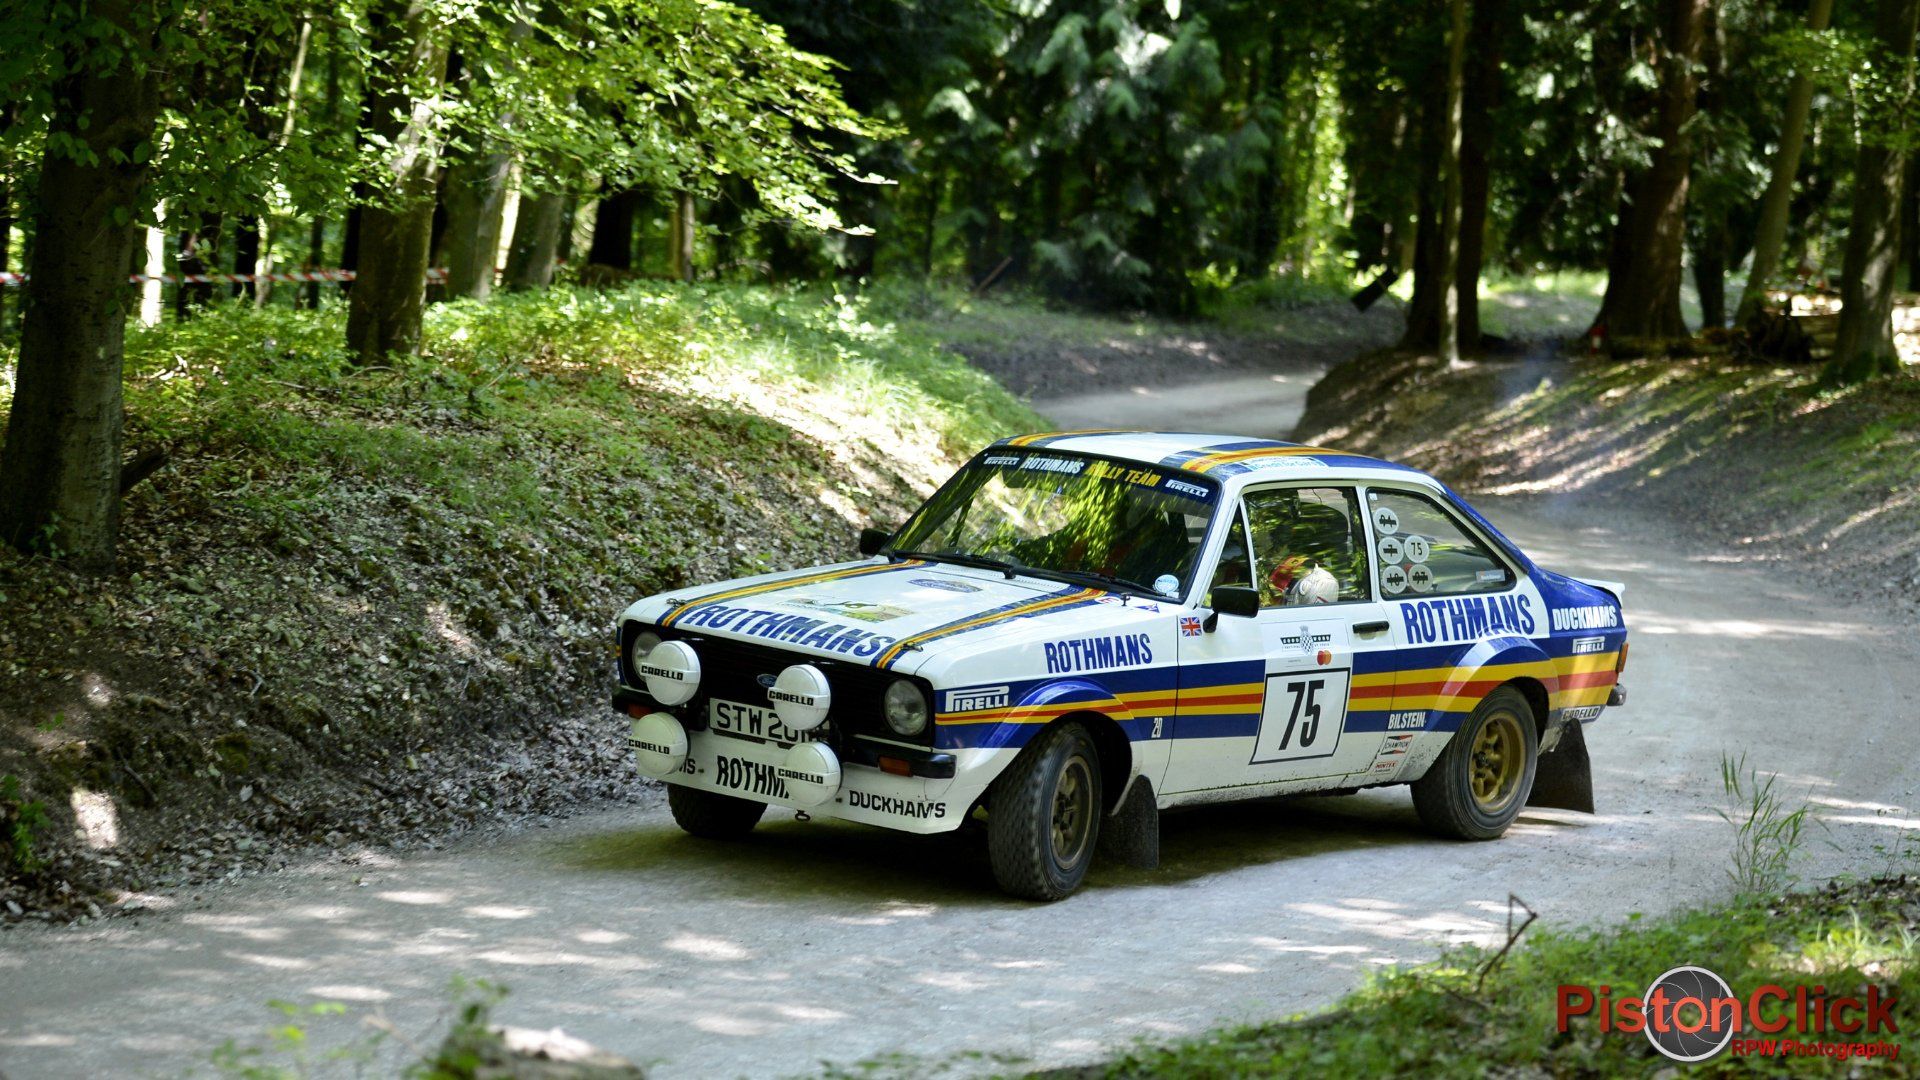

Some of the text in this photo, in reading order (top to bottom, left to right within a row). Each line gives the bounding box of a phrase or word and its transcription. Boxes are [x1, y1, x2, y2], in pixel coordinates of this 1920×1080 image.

[983, 455, 1020, 466] PIRELLI
[1020, 457, 1085, 474] ROTHMANS
[1124, 469, 1162, 488] TEAM
[1165, 478, 1209, 498] PIRELLI
[1411, 542, 1423, 556] 75
[683, 605, 897, 656] ROTHMANS
[1400, 593, 1535, 644] ROTHMANS
[1552, 605, 1618, 631] DUCKHAMS
[1043, 633, 1153, 673] ROTHMANS
[1572, 636, 1605, 654] PIRELLI
[641, 665, 684, 681] CARELLO
[768, 690, 814, 706] CARELLO
[945, 685, 1010, 712] PIRELLI
[716, 702, 762, 736] STW
[1278, 679, 1325, 751] 75
[1388, 712, 1426, 730] BILSTEIN
[628, 738, 670, 755] CARELLO
[716, 755, 789, 799] ROTHM
[778, 768, 824, 785] CARELLO
[849, 790, 946, 818] DUCKHAMS
